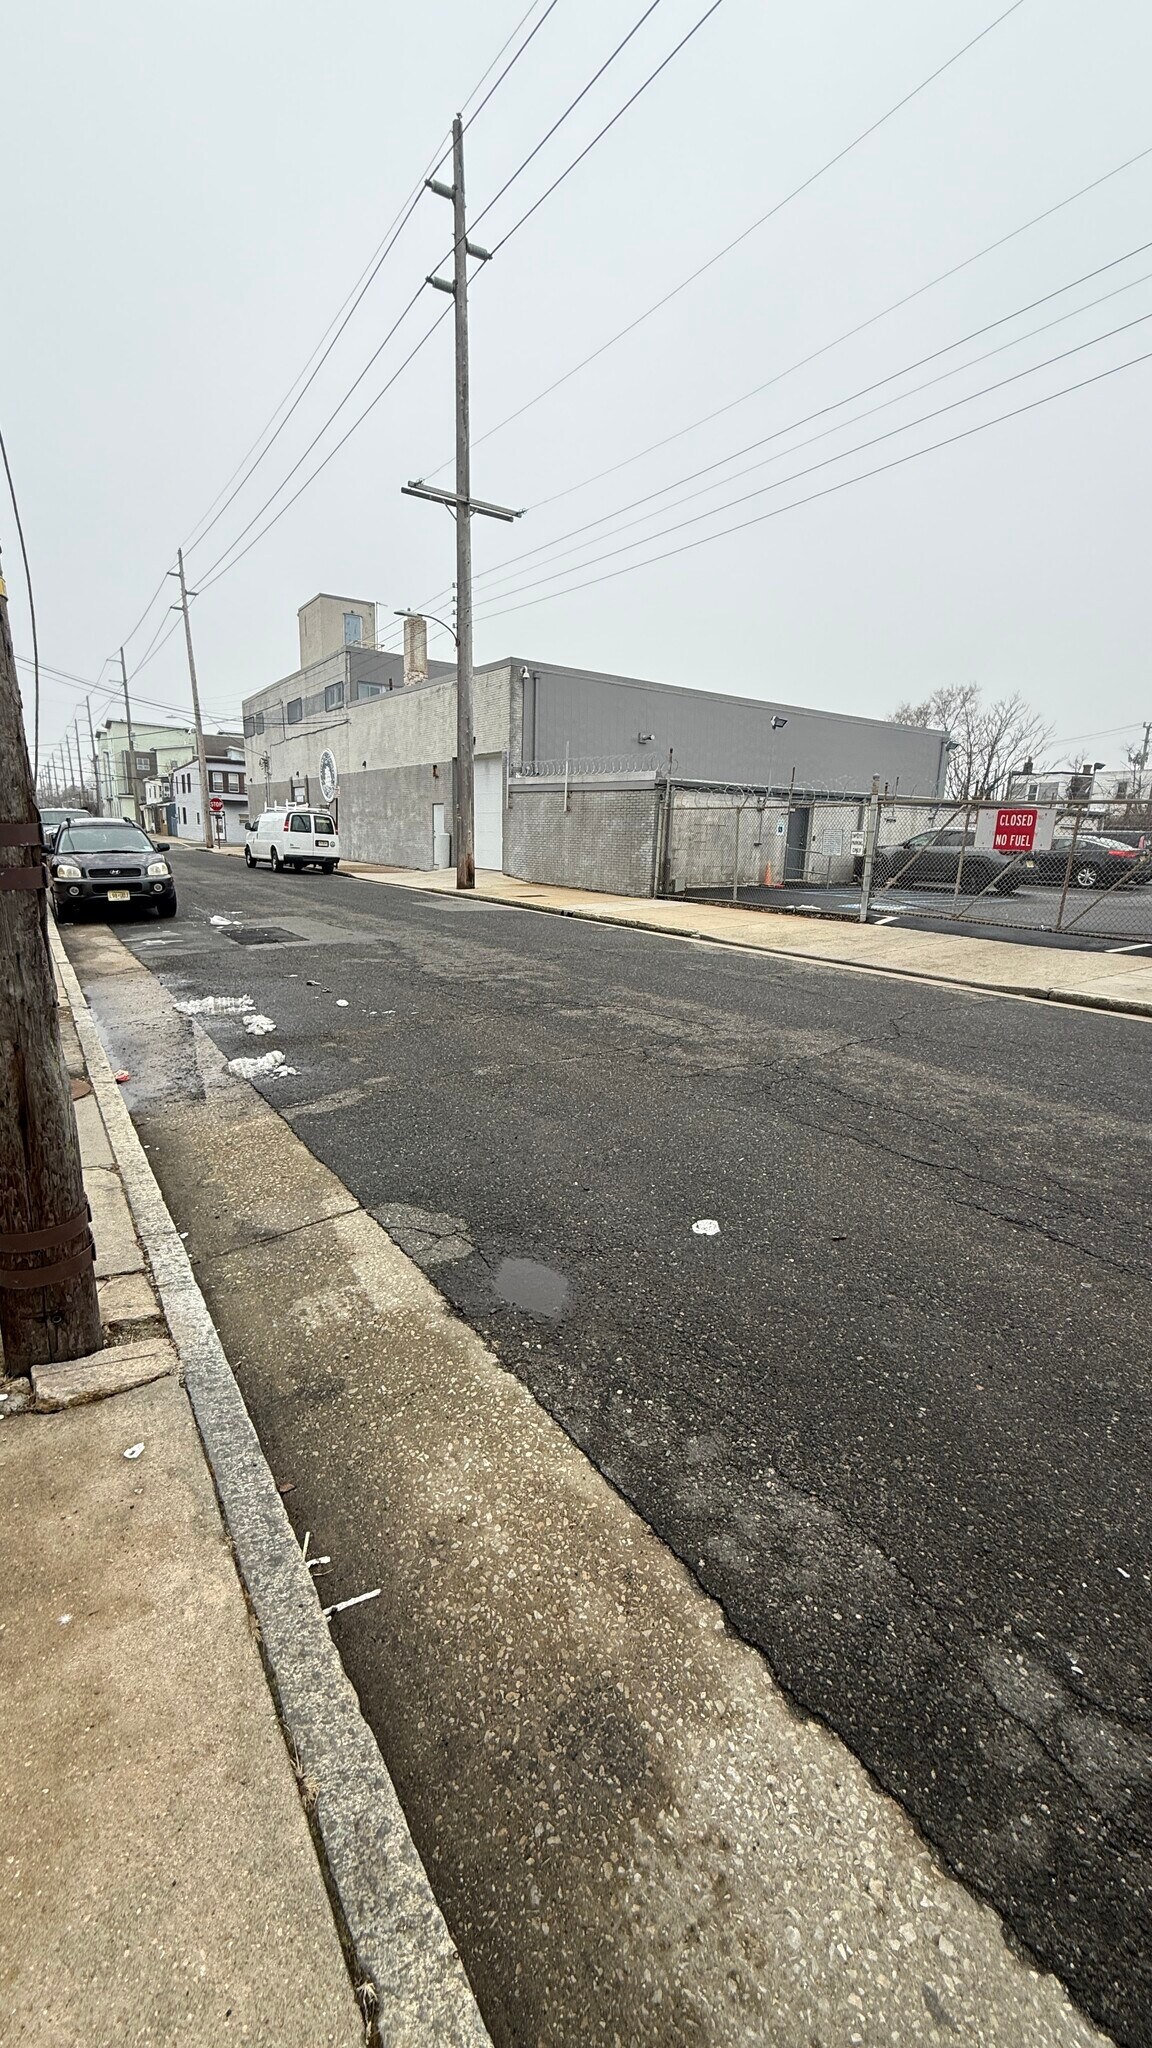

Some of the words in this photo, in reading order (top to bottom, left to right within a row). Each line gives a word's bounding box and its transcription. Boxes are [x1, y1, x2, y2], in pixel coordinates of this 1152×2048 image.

[1000, 814, 1033, 826] CLOSED
[995, 834, 1007, 846] NO
[1009, 834, 1031, 846] FUEL
